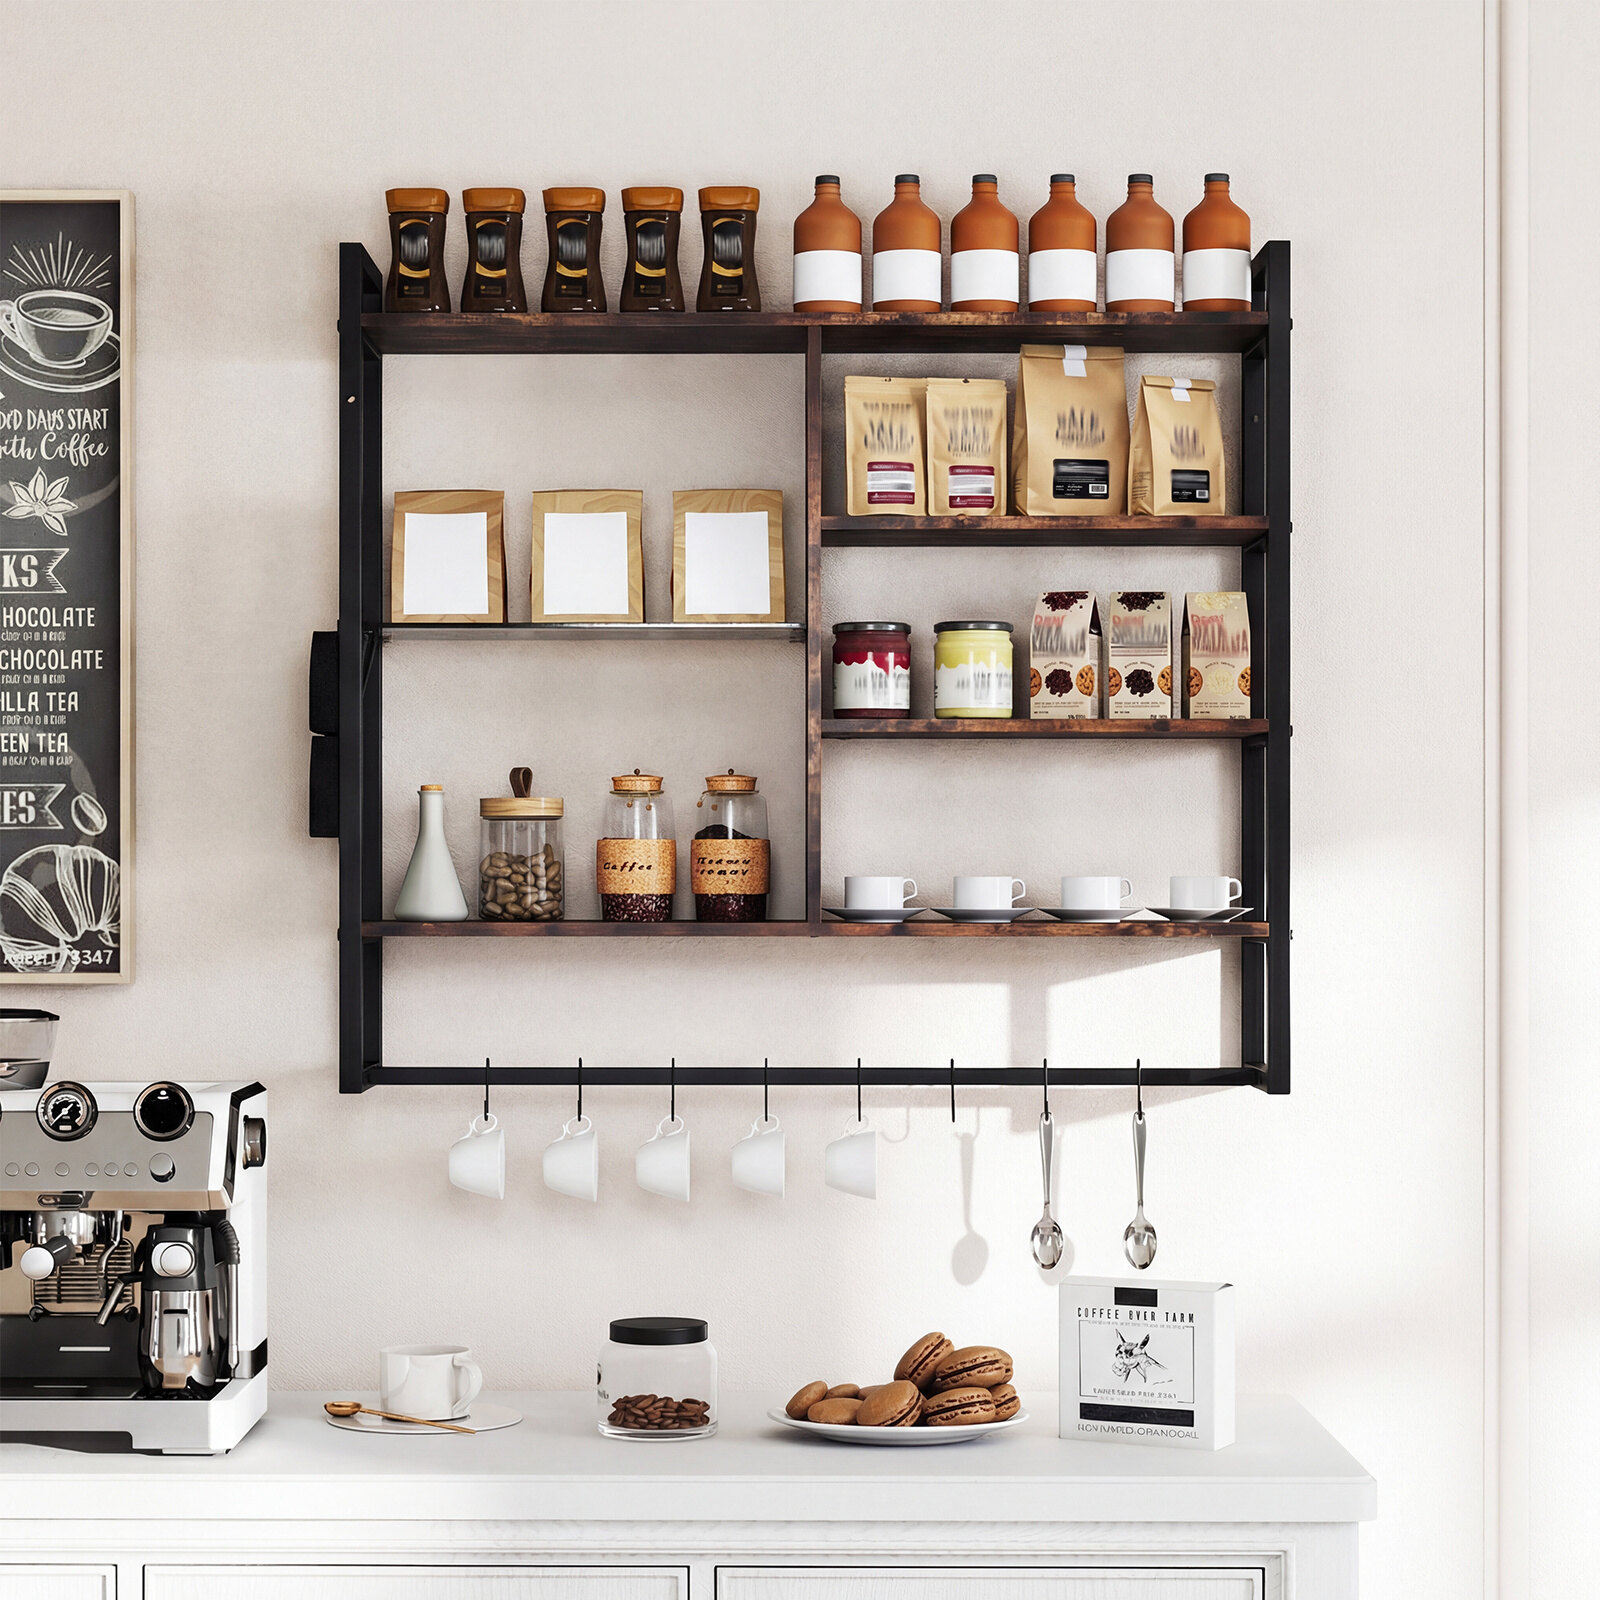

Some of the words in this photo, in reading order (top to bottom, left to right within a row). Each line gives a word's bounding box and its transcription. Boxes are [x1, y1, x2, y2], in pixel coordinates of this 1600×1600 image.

[67, 408, 109, 430] START
[40, 431, 109, 467] Coffee
[2, 606, 96, 628] HOCOLATE
[0, 648, 104, 670] CHOCOLATE
[46, 691, 79, 712] TEA
[36, 732, 69, 753] TEA
[1077, 1307, 1120, 1320] COFFEE
